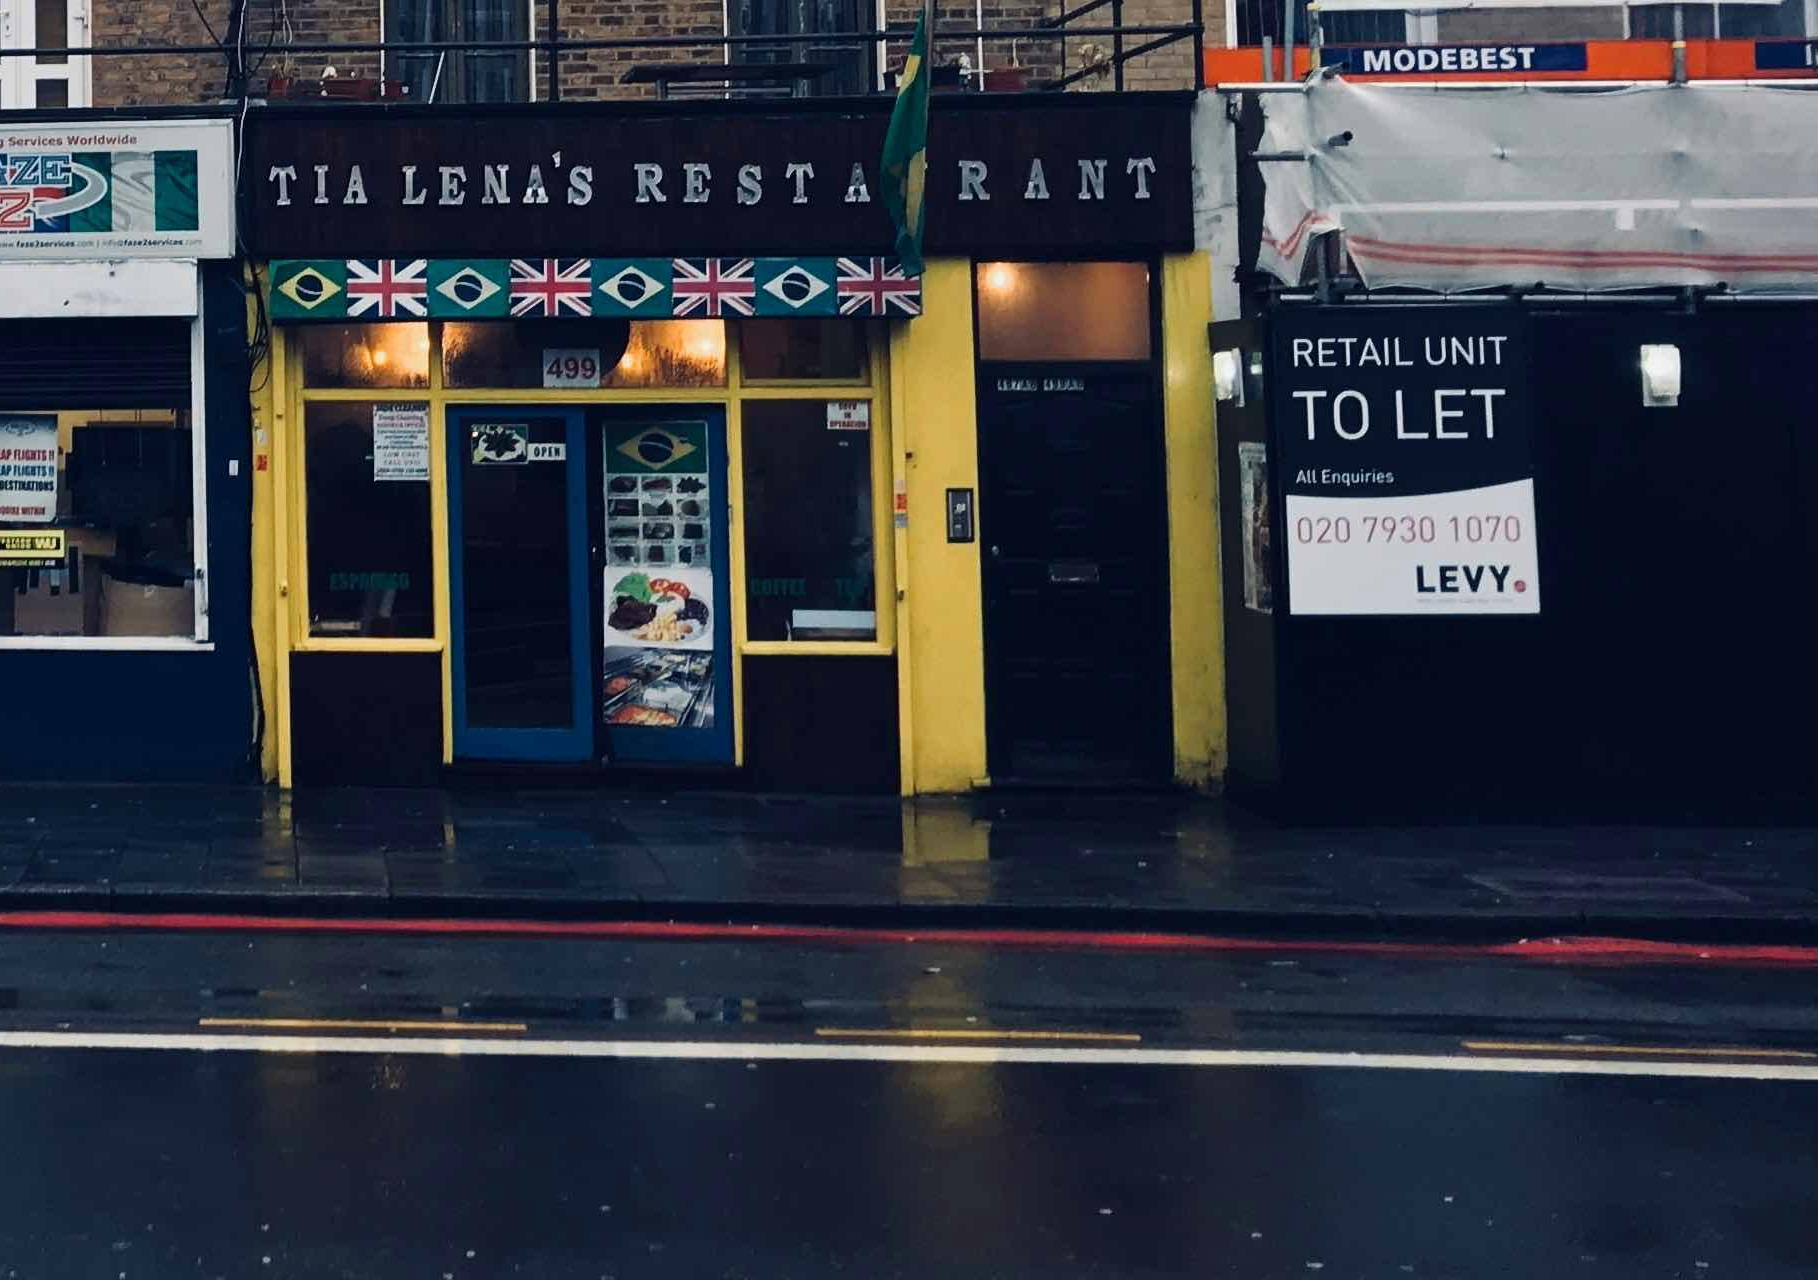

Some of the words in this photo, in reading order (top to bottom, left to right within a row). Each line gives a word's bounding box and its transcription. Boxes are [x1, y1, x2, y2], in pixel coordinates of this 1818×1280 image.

[1363, 47, 1536, 72] MODEBEST
[8, 135, 63, 147] Services
[66, 134, 137, 146] Worldwide
[269, 164, 368, 206] TIA
[402, 152, 593, 205] LENA'S
[634, 157, 1157, 205] RESTARANT
[1293, 337, 1414, 368] RETAIL
[1424, 336, 1508, 366] UNIT
[546, 358, 597, 379] 499
[1292, 389, 1370, 441] TO
[1395, 388, 1506, 440] LET
[14, 449, 47, 461] FLIGHTS
[533, 447, 561, 458] OPEN
[0, 480, 55, 492] DESTINATIONS
[1295, 469, 1317, 485] All
[1321, 468, 1395, 487] Enquiries
[1297, 516, 1351, 544] 020
[1362, 515, 1436, 544] 7930
[1446, 515, 1522, 543] 1070
